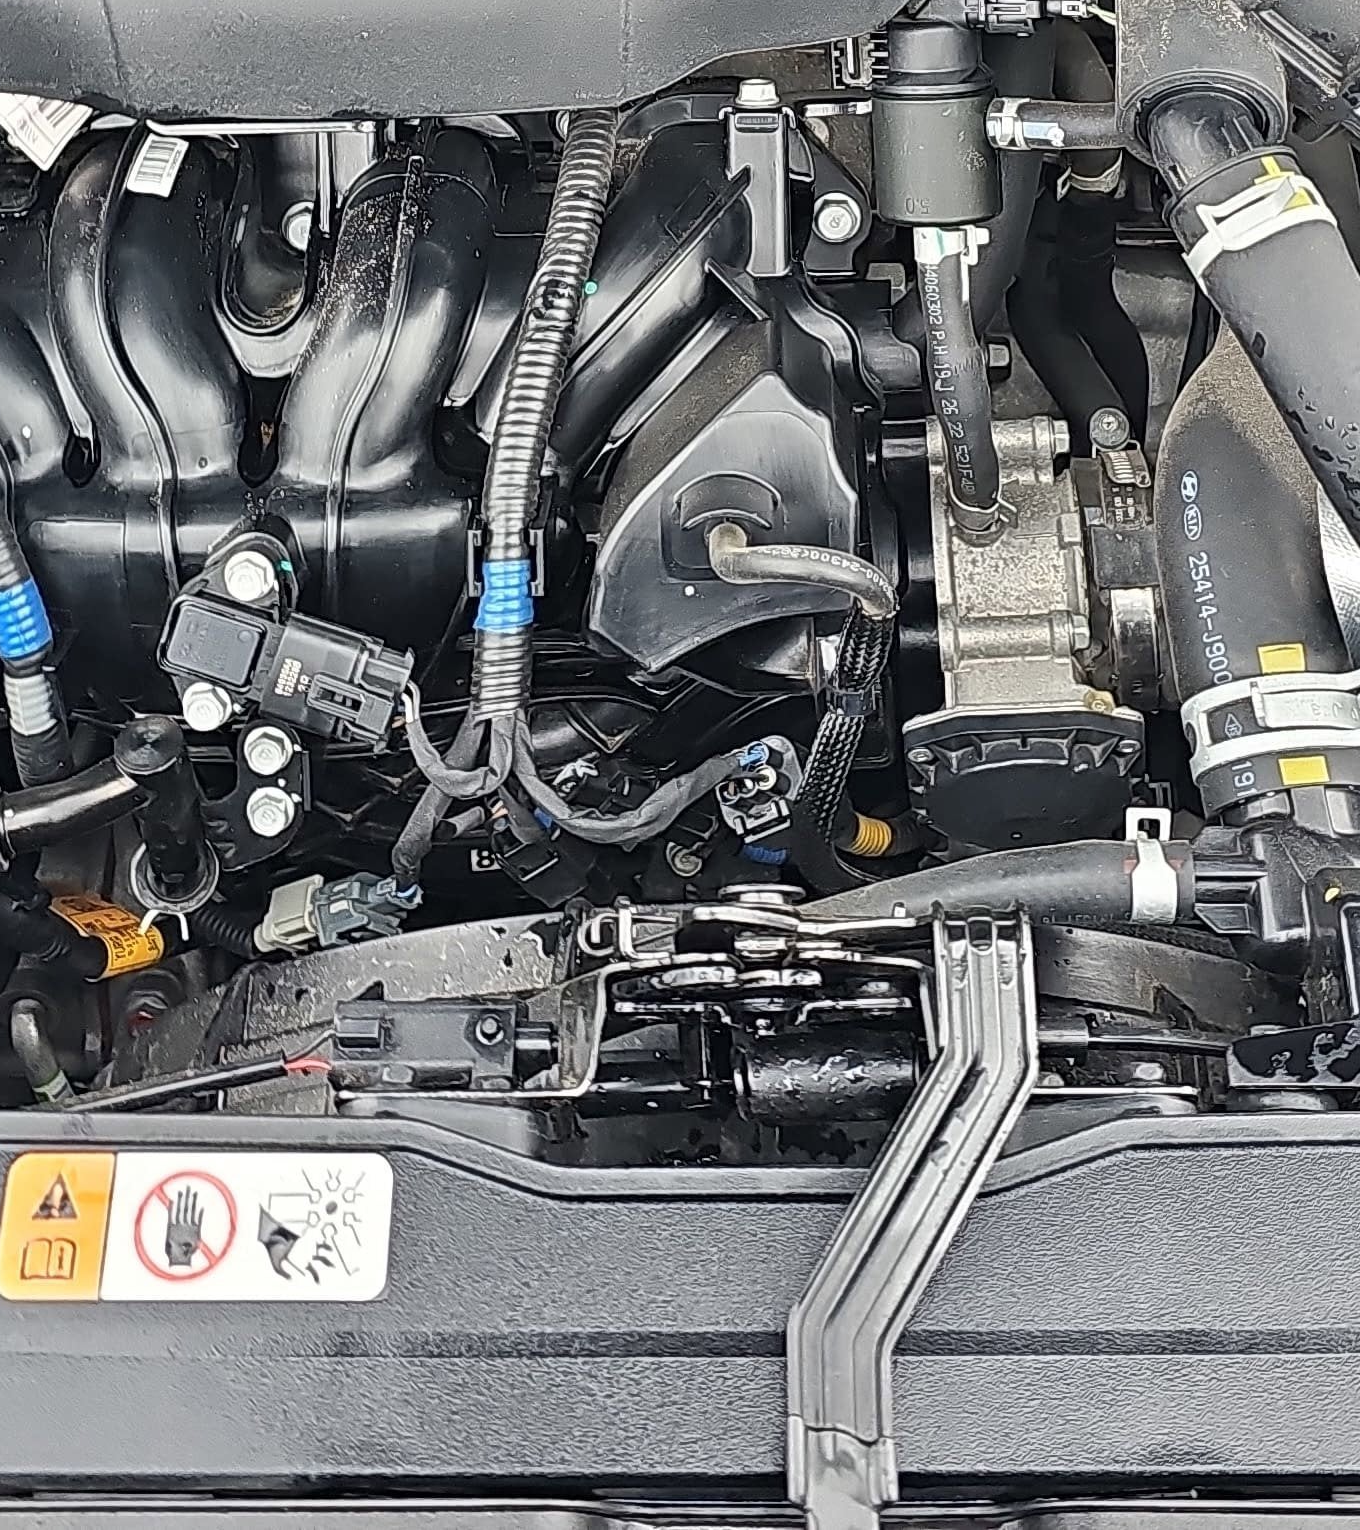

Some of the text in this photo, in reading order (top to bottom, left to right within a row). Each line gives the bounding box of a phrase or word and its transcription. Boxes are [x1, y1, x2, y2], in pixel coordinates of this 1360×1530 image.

[941, 399, 959, 415] 26
[948, 421, 964, 439] 22
[1184, 507, 1201, 539] KIA
